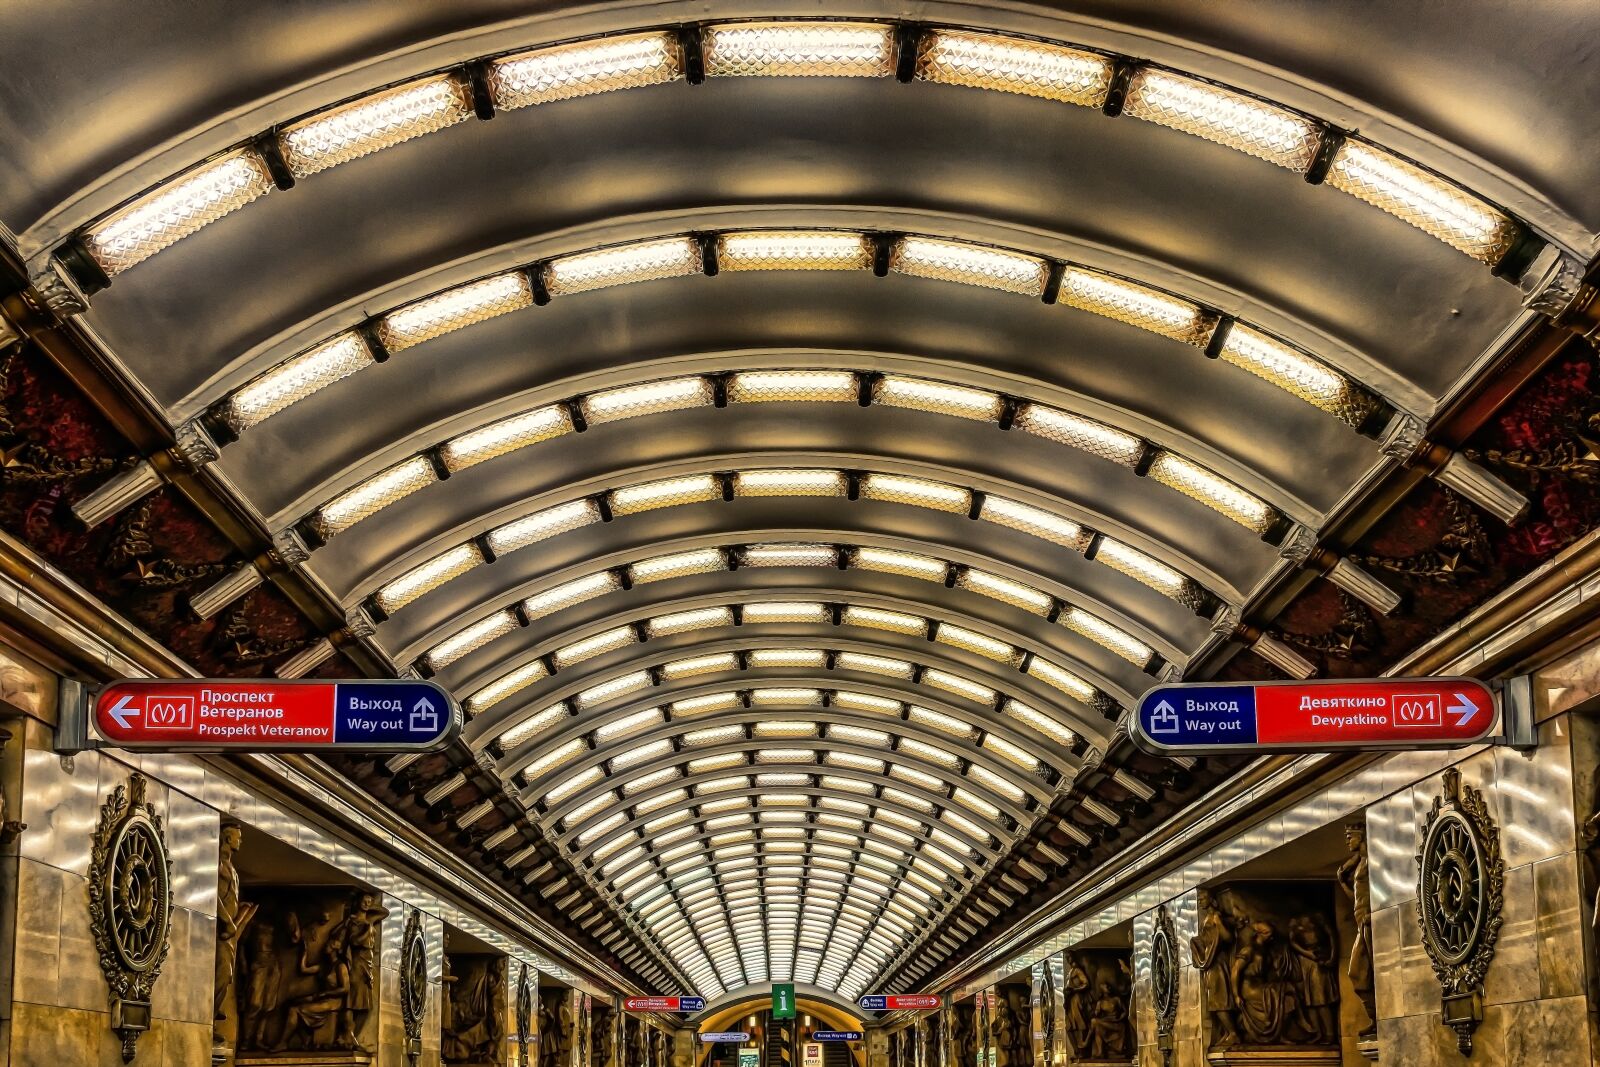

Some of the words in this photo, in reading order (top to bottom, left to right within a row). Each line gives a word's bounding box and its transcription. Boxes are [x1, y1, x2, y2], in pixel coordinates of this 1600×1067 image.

[200, 689, 275, 705] Проспект
[349, 697, 403, 712] Выход
[1299, 695, 1387, 711] Девяткино
[199, 705, 285, 720] Ветеранов
[1185, 699, 1239, 714] Выход
[347, 718, 377, 732] Way
[379, 718, 404, 731] out
[1184, 718, 1217, 732] Way
[1218, 719, 1242, 731] out
[1310, 713, 1388, 728] Devyatkino
[199, 723, 259, 737] Prospekt
[260, 724, 330, 737] Veteranov
